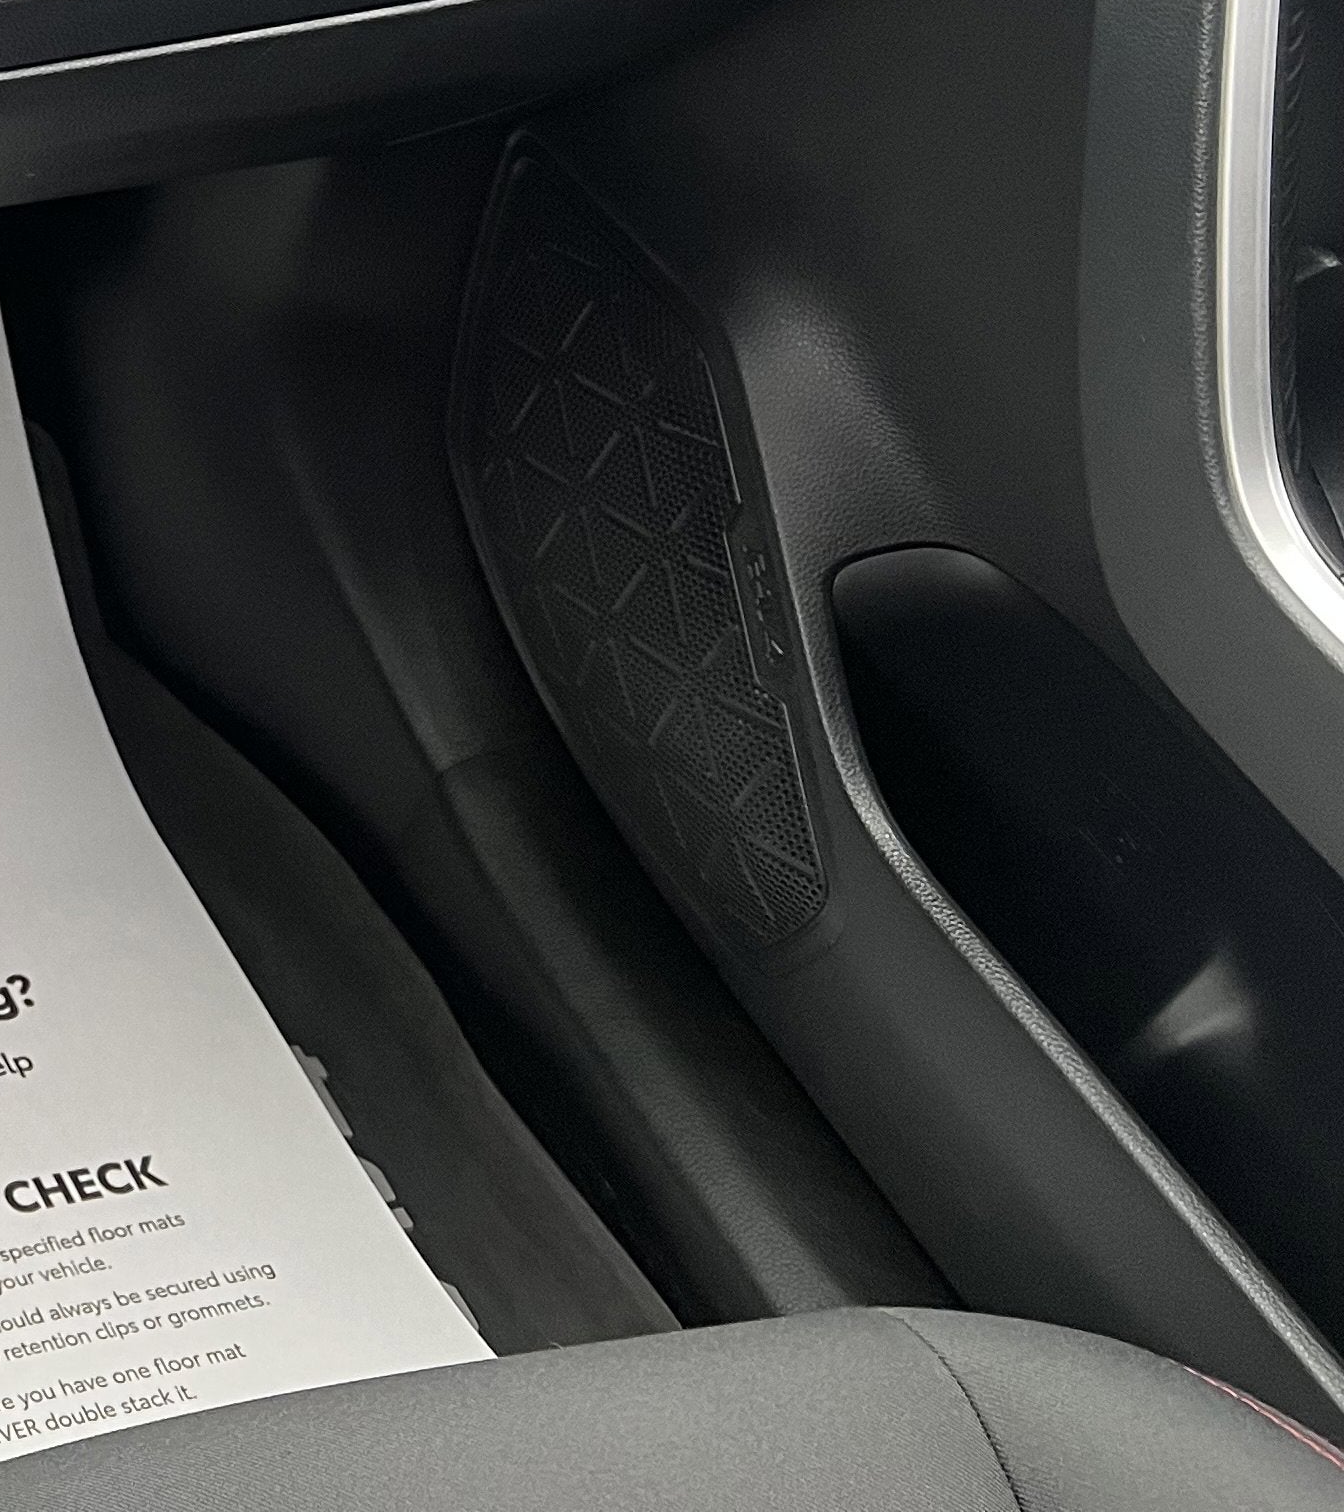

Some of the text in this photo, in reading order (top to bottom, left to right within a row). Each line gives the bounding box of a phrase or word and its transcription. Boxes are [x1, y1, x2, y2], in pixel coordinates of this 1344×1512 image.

[4, 1155, 169, 1214] CHECK
[0, 1228, 86, 1265] specified
[89, 1222, 133, 1243] floor
[138, 1211, 186, 1232] mats
[38, 1255, 112, 1283] vehicle.
[49, 1295, 112, 1327] always
[112, 1287, 142, 1307] be
[145, 1270, 220, 1301] secured
[224, 1261, 277, 1291] using
[3, 1328, 92, 1361] retention
[95, 1319, 140, 1343] clips
[144, 1315, 163, 1330] or
[167, 1297, 271, 1329] grommets.
[19, 1385, 57, 1411] you
[61, 1372, 109, 1397] have
[112, 1364, 150, 1384] one
[154, 1352, 202, 1376] floor
[206, 1343, 247, 1365] mat
[45, 1403, 117, 1432] double
[121, 1388, 175, 1415] stack
[177, 1384, 198, 1404] it.
